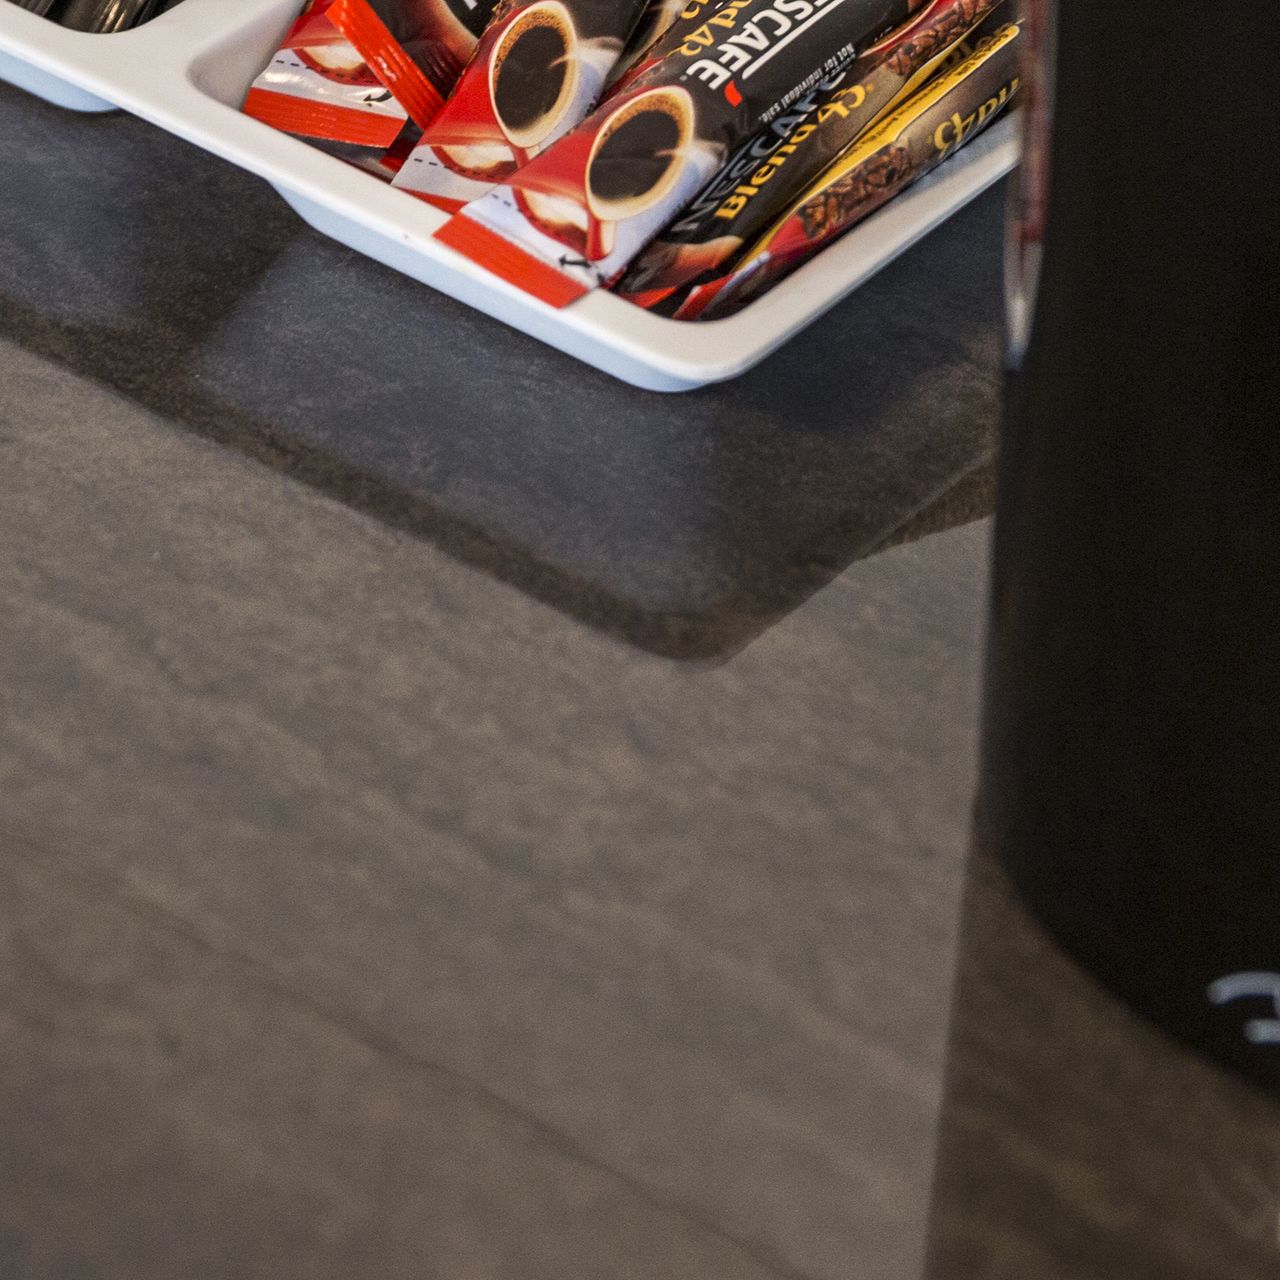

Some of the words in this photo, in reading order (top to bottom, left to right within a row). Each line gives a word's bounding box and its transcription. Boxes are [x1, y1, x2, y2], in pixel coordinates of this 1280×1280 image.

[823, 54, 839, 72] for
[838, 42, 856, 59] Not
[780, 67, 824, 109] individual
[713, 123, 818, 220] Blend
